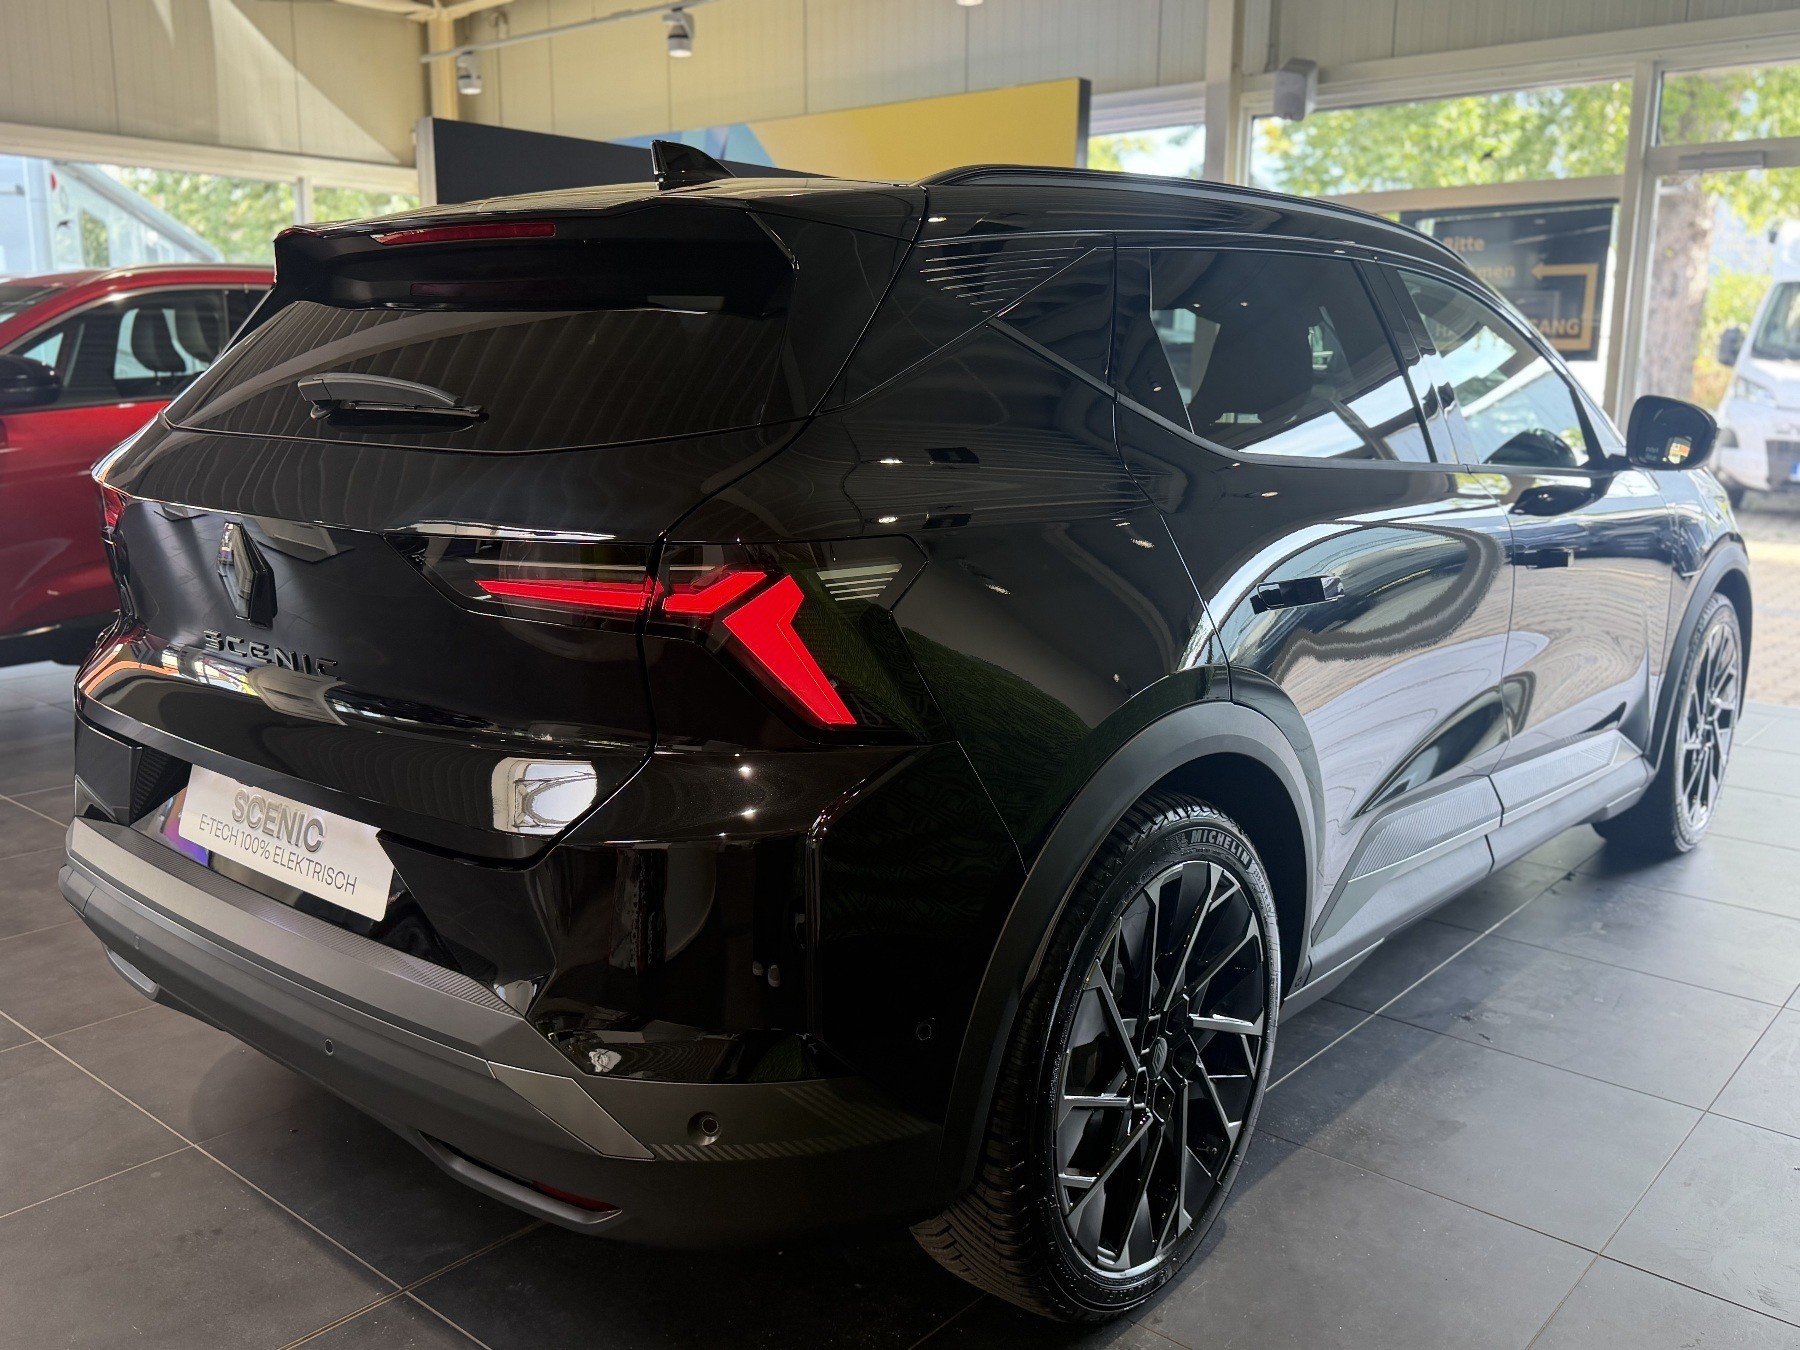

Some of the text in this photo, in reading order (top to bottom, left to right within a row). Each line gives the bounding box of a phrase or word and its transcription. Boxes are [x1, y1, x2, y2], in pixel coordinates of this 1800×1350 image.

[203, 629, 341, 681] SCENIC
[232, 789, 326, 852] SCENIC
[1190, 829, 1250, 866] MICHELIN
[199, 813, 357, 895] E-TECH 100% ELEKTRISCH
